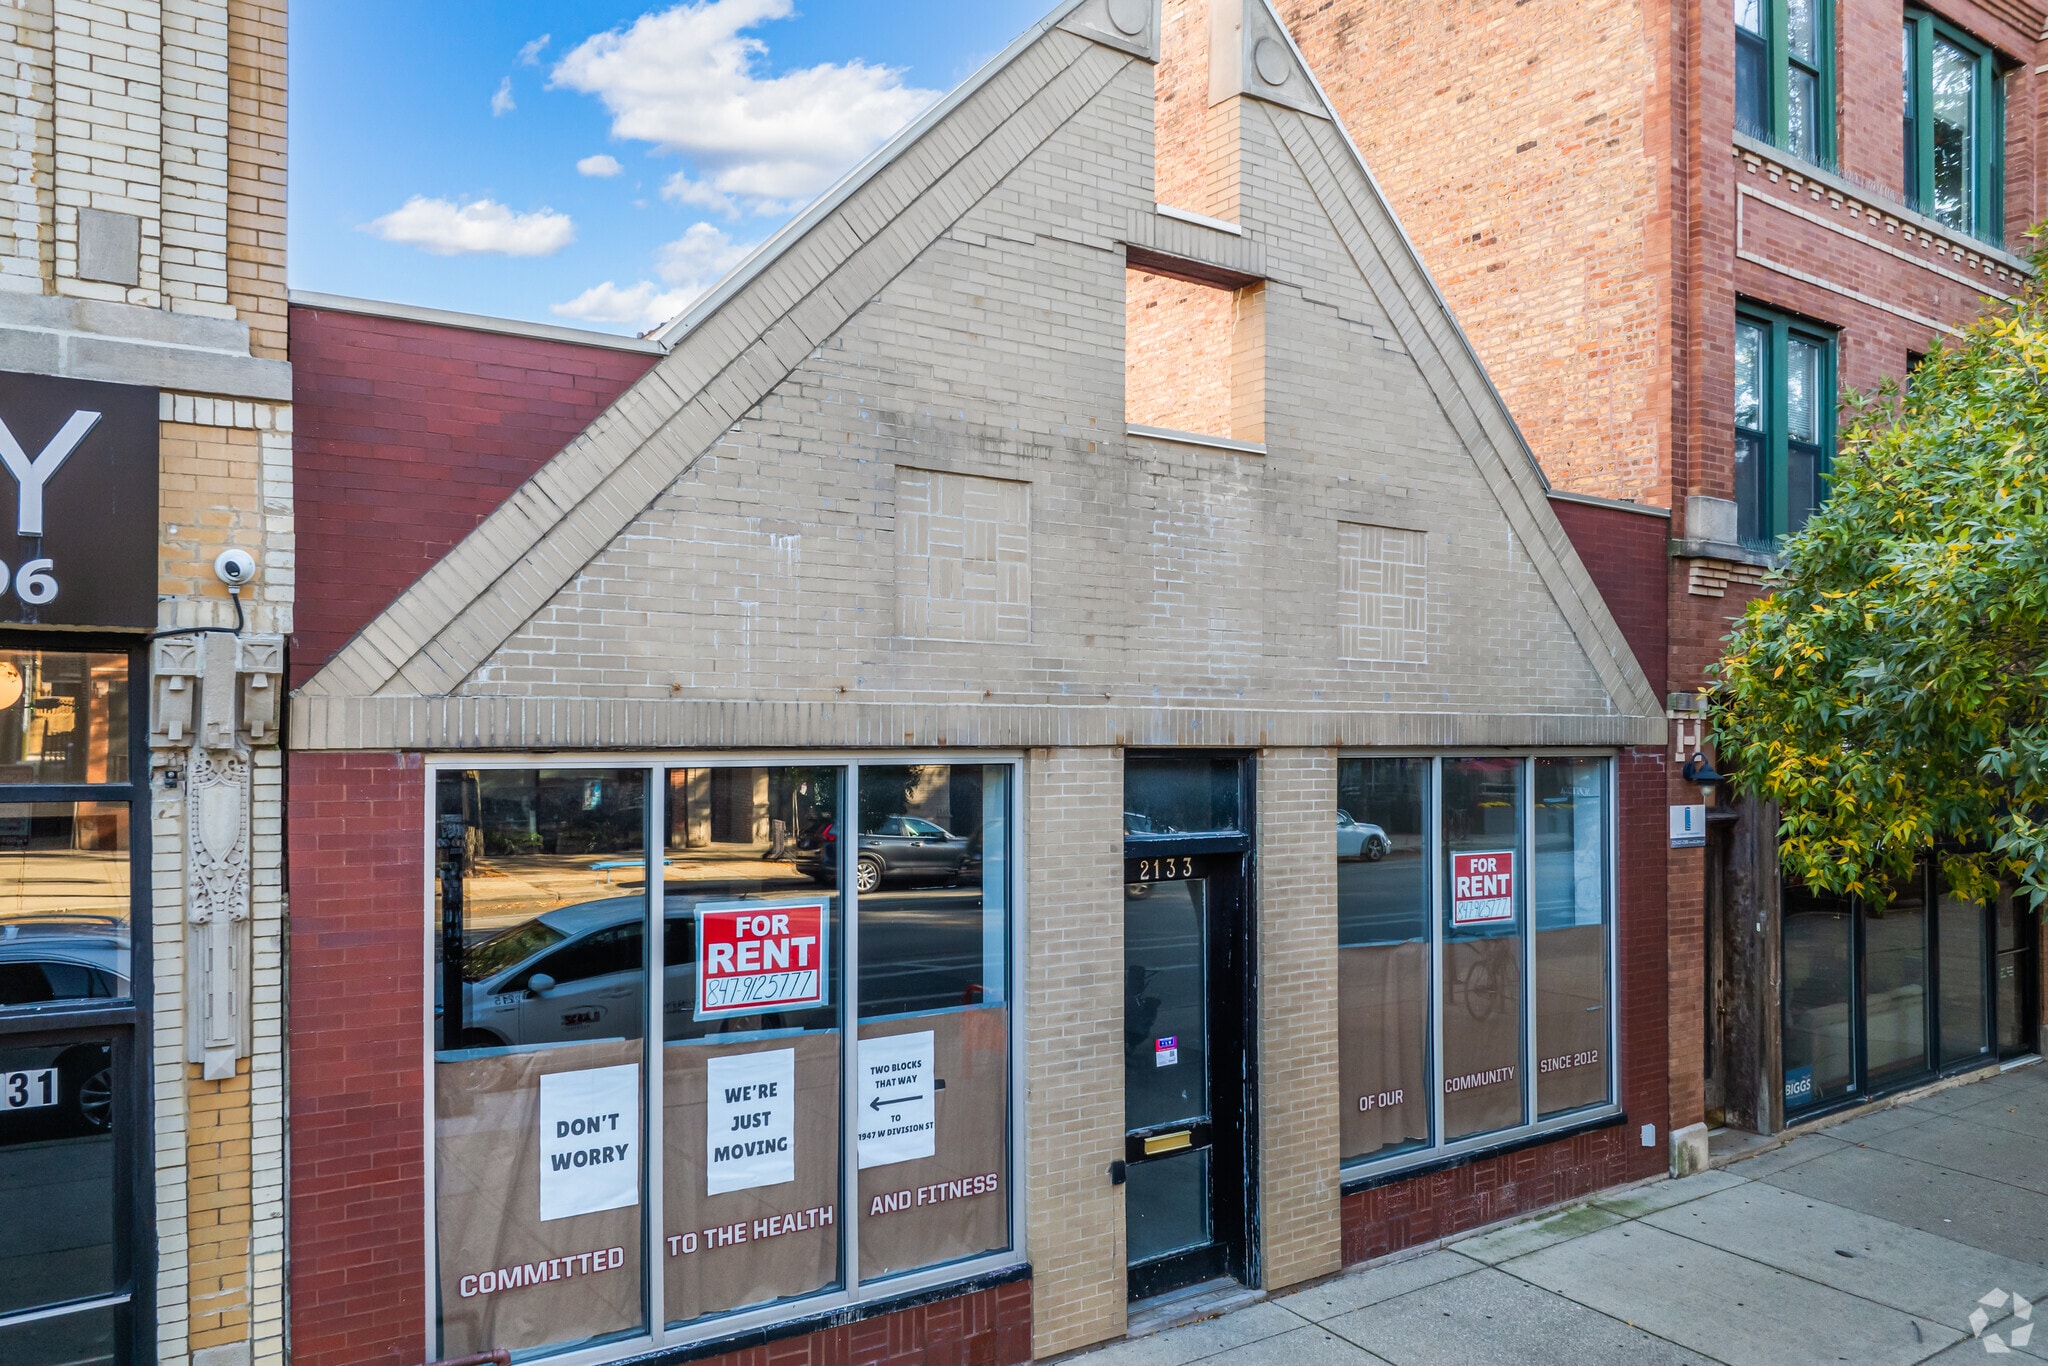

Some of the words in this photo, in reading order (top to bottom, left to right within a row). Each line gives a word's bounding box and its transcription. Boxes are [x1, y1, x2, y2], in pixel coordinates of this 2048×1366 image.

[1140, 857, 1192, 880] 2133
[1470, 857, 1497, 874] FOR
[1457, 873, 1510, 898] RENT
[736, 914, 790, 938] FOR
[707, 936, 816, 975] RENT
[870, 1065, 890, 1075] TWO
[891, 1060, 922, 1072] BLOCKS
[875, 1077, 897, 1089] THAT
[898, 1074, 917, 1085] WAY
[1359, 1094, 1376, 1112] OF
[1378, 1089, 1404, 1109] OUR
[1444, 1066, 1516, 1094] COMMUNITY
[1540, 1052, 1572, 1074] SINCE
[1573, 1050, 1598, 1068] 2012
[1785, 1078, 1811, 1096] BIGGS
[724, 1082, 778, 1104] WE'RE
[556, 1113, 620, 1139] DON'T
[731, 1111, 772, 1132] JUST
[891, 1114, 901, 1122] TO
[858, 1131, 876, 1141] 1947
[877, 1130, 886, 1138] W
[887, 1123, 924, 1135] DIVISION
[925, 1121, 934, 1130] ST
[551, 1143, 629, 1172] WORRY
[714, 1136, 788, 1163] MOVING
[459, 1246, 625, 1298] COMMITTED
[667, 1232, 698, 1258] TO
[703, 1222, 748, 1250] THE
[753, 1205, 834, 1241] HEALTH
[869, 1188, 912, 1217] AND
[916, 1172, 999, 1207] FITNESS
